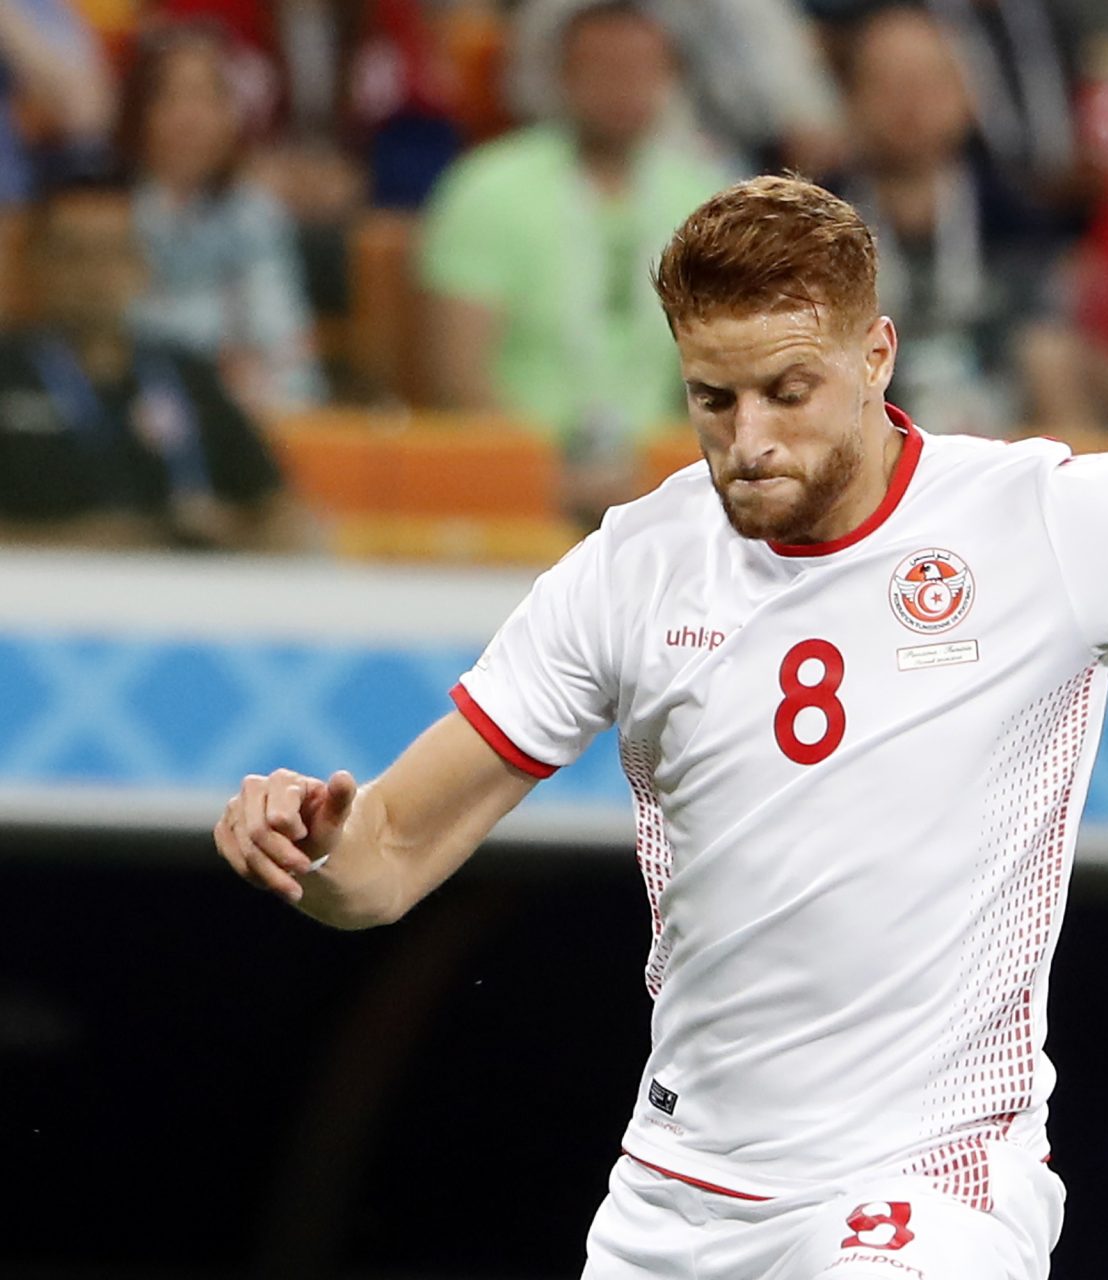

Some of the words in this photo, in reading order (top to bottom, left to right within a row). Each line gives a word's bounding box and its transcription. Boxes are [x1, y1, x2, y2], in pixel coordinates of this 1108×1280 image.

[665, 625, 726, 651] uhlsp
[774, 638, 846, 765] 8
[841, 1201, 915, 1251] 8
